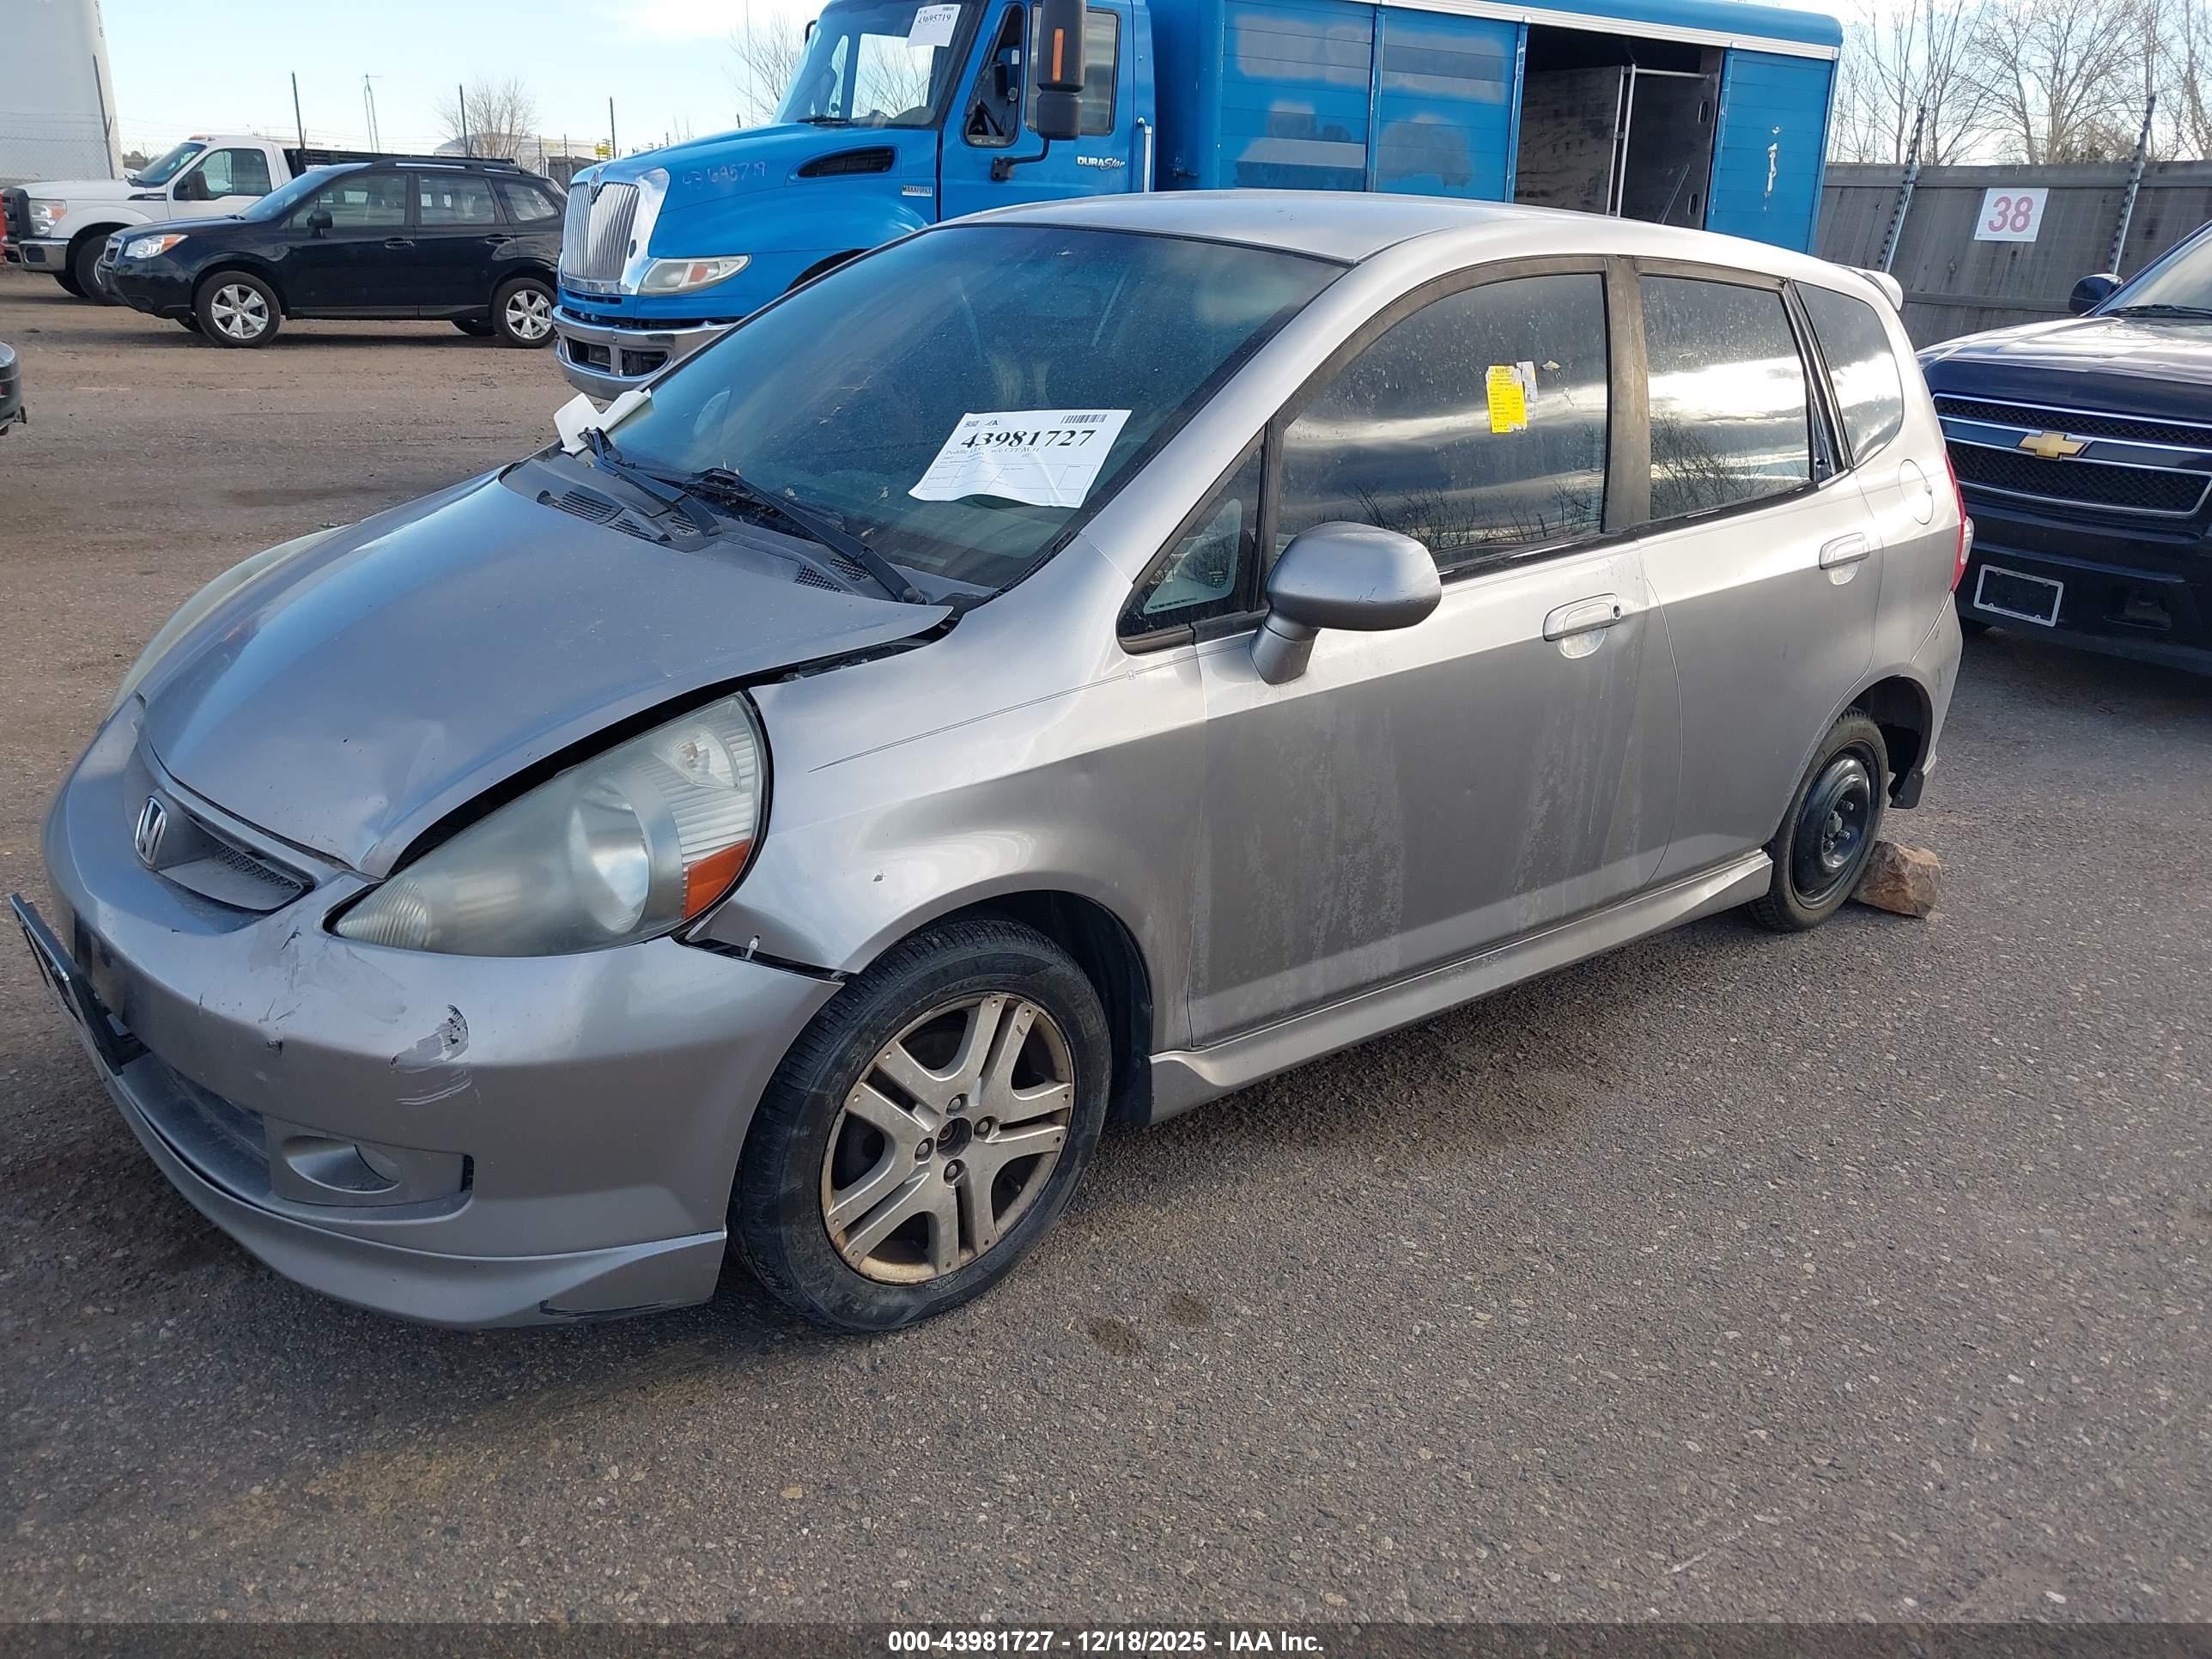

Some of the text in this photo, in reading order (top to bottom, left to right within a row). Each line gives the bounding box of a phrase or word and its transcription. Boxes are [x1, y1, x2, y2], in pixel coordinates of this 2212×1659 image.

[917, 14, 951, 24] 43695719
[1076, 155, 1126, 170] DURAStar
[1988, 196, 2034, 233] 38
[961, 430, 1097, 448] 43981727
